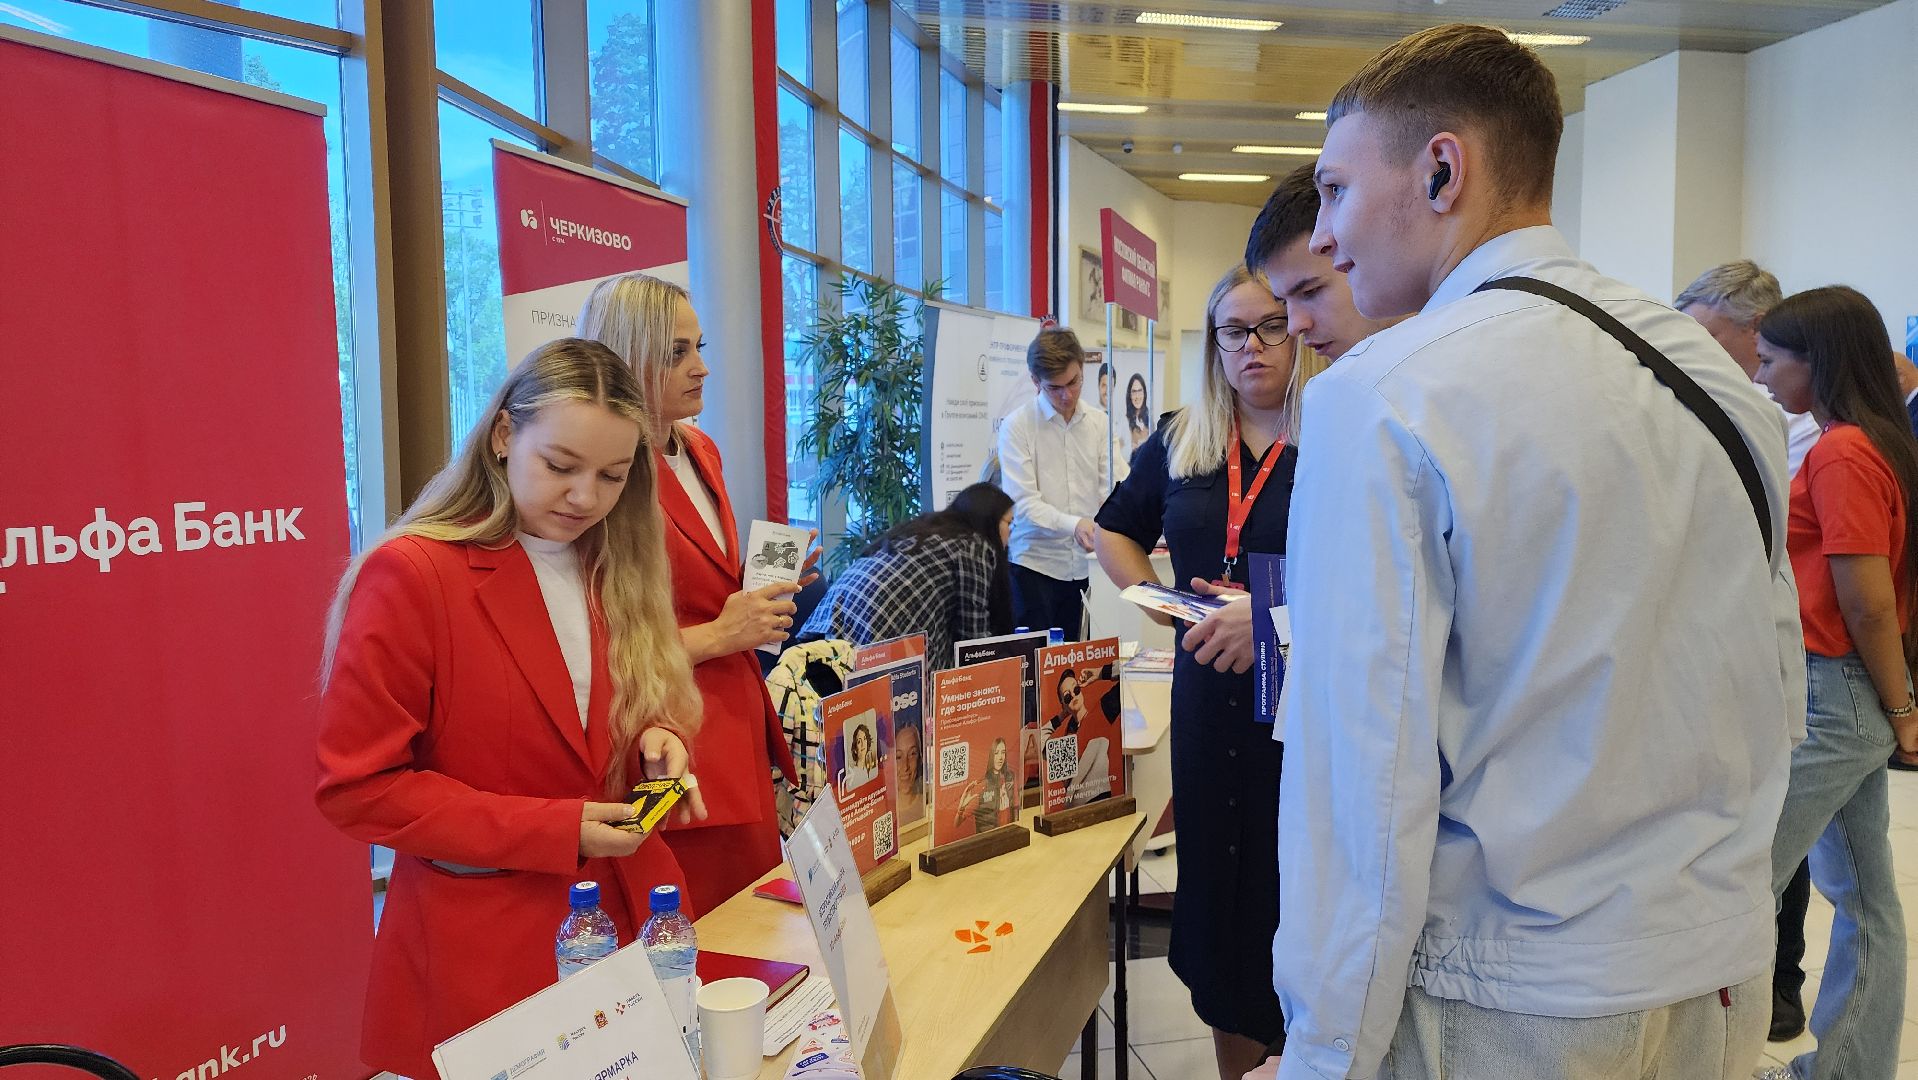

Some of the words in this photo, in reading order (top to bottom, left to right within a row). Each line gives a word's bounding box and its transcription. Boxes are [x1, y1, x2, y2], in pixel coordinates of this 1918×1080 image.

[550, 216, 632, 251] ЧЕРКИЗОВО
[0, 507, 163, 573] льфа
[174, 501, 306, 552] Банк
[1043, 648, 1084, 668] Альфа
[1085, 645, 1116, 660] Банк
[940, 690, 972, 704] Умные
[972, 685, 1001, 697] знают,
[940, 705, 956, 717] где
[956, 695, 1006, 711] заработать
[1047, 786, 1066, 798] Квиз
[1048, 795, 1073, 809] работу
[151, 1024, 287, 1080] ank.ru
